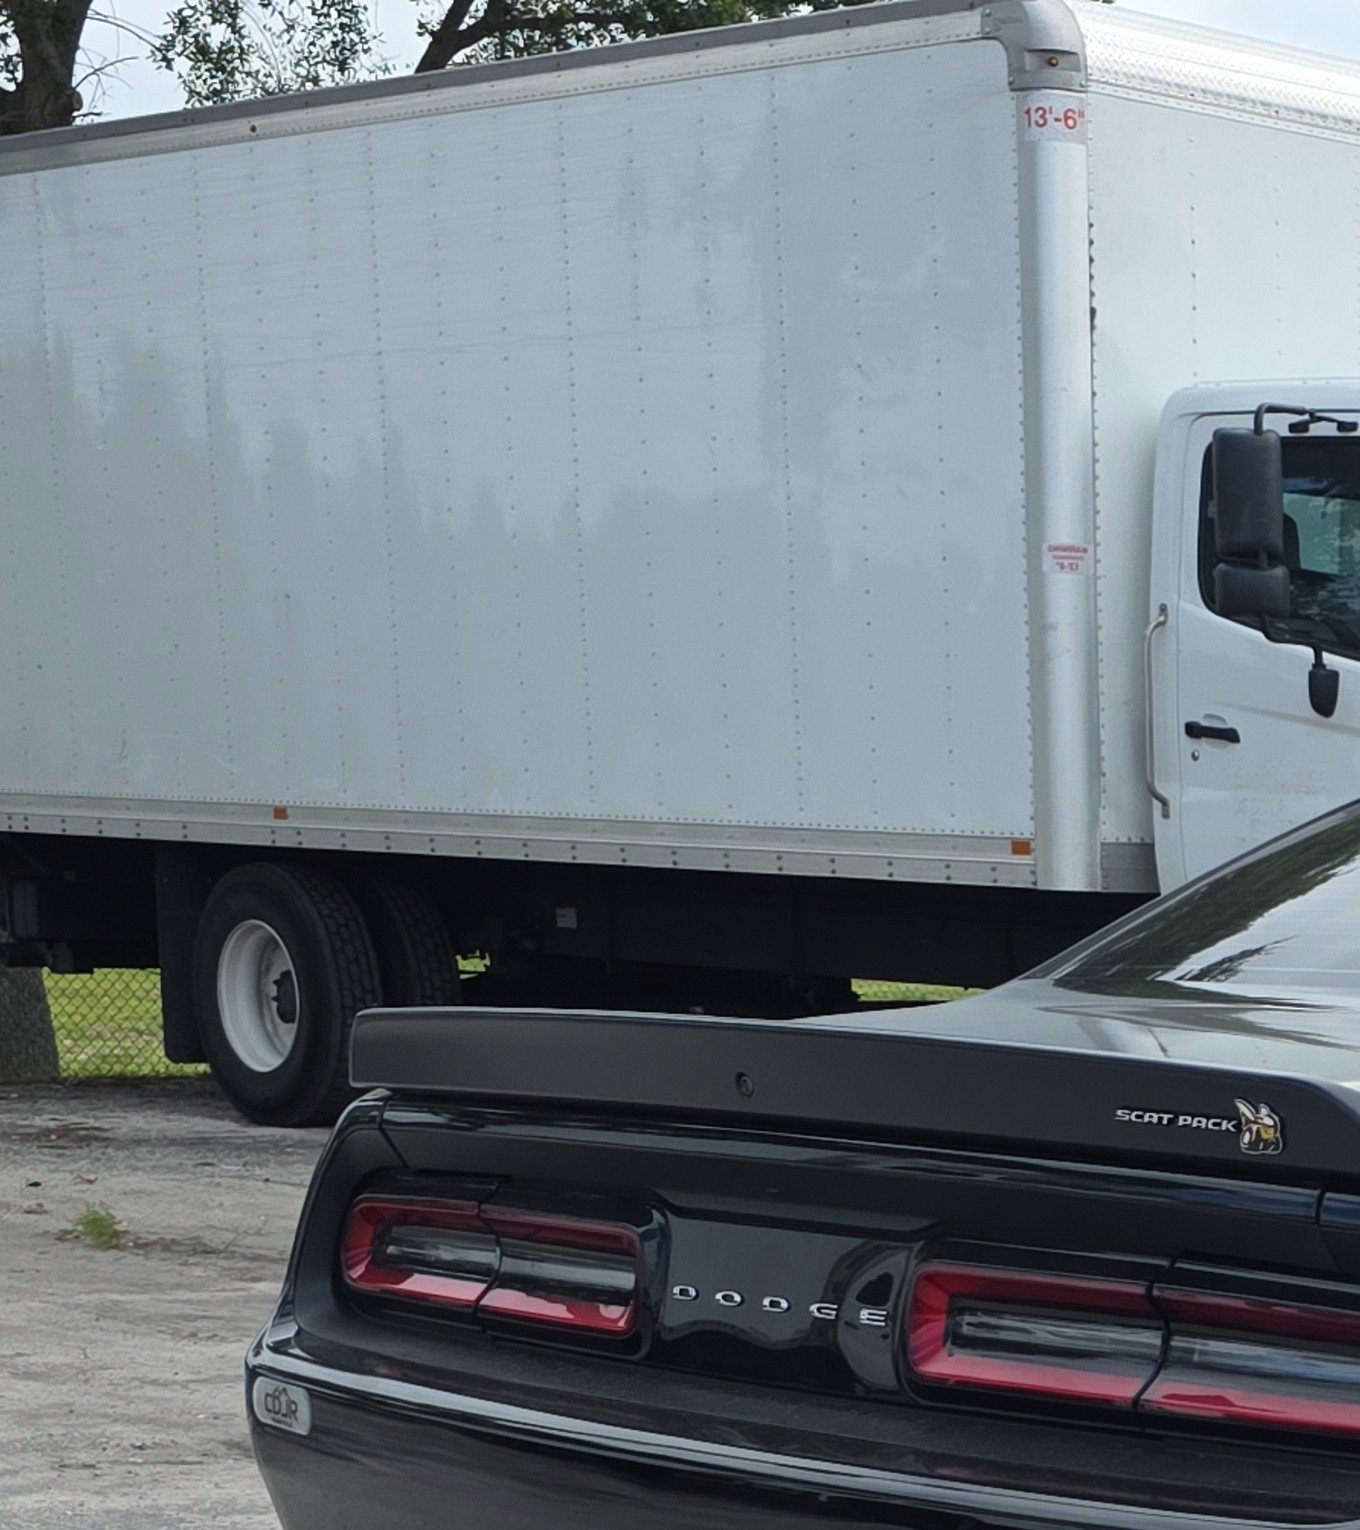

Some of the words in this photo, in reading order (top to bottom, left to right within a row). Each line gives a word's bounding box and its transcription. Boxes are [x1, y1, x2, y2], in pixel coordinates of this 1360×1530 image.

[1023, 106, 1085, 130] 13'-6"
[1114, 1109, 1174, 1125] SCAT
[1177, 1115, 1239, 1132] PACK
[672, 1285, 888, 1326] DODGE
